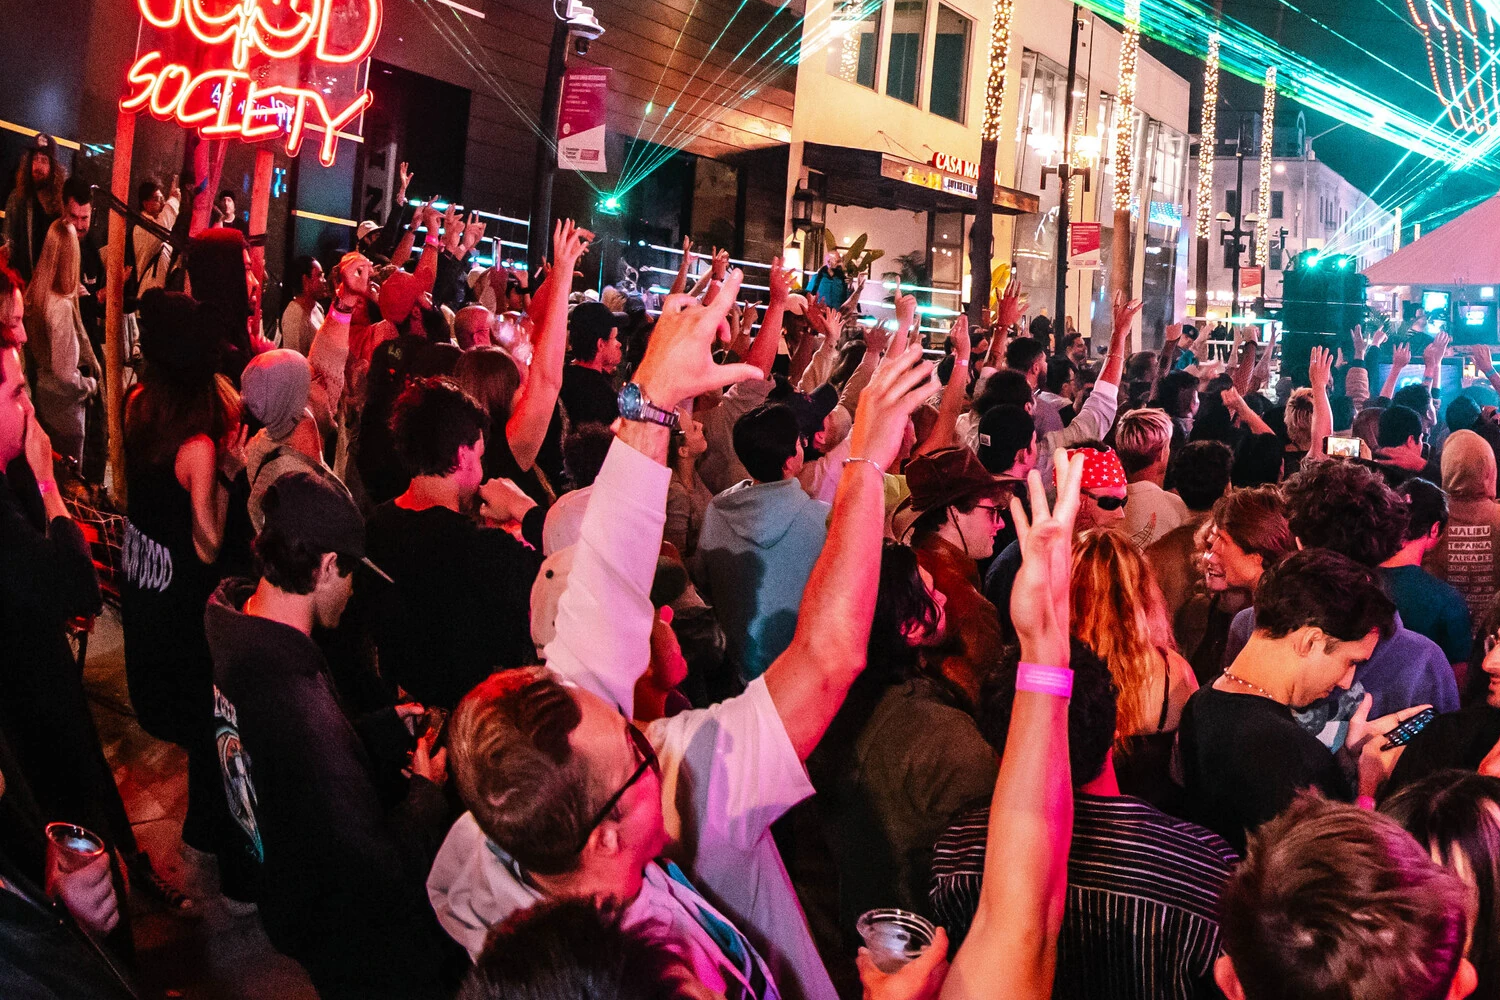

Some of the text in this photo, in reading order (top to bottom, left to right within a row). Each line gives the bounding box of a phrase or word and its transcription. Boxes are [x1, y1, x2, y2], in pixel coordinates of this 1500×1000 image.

[121, 51, 371, 161] SOCIETY
[936, 152, 1002, 185] CASA MAN
[1449, 526, 1490, 536] MALIBU
[1449, 542, 1491, 550] TOPANGA
